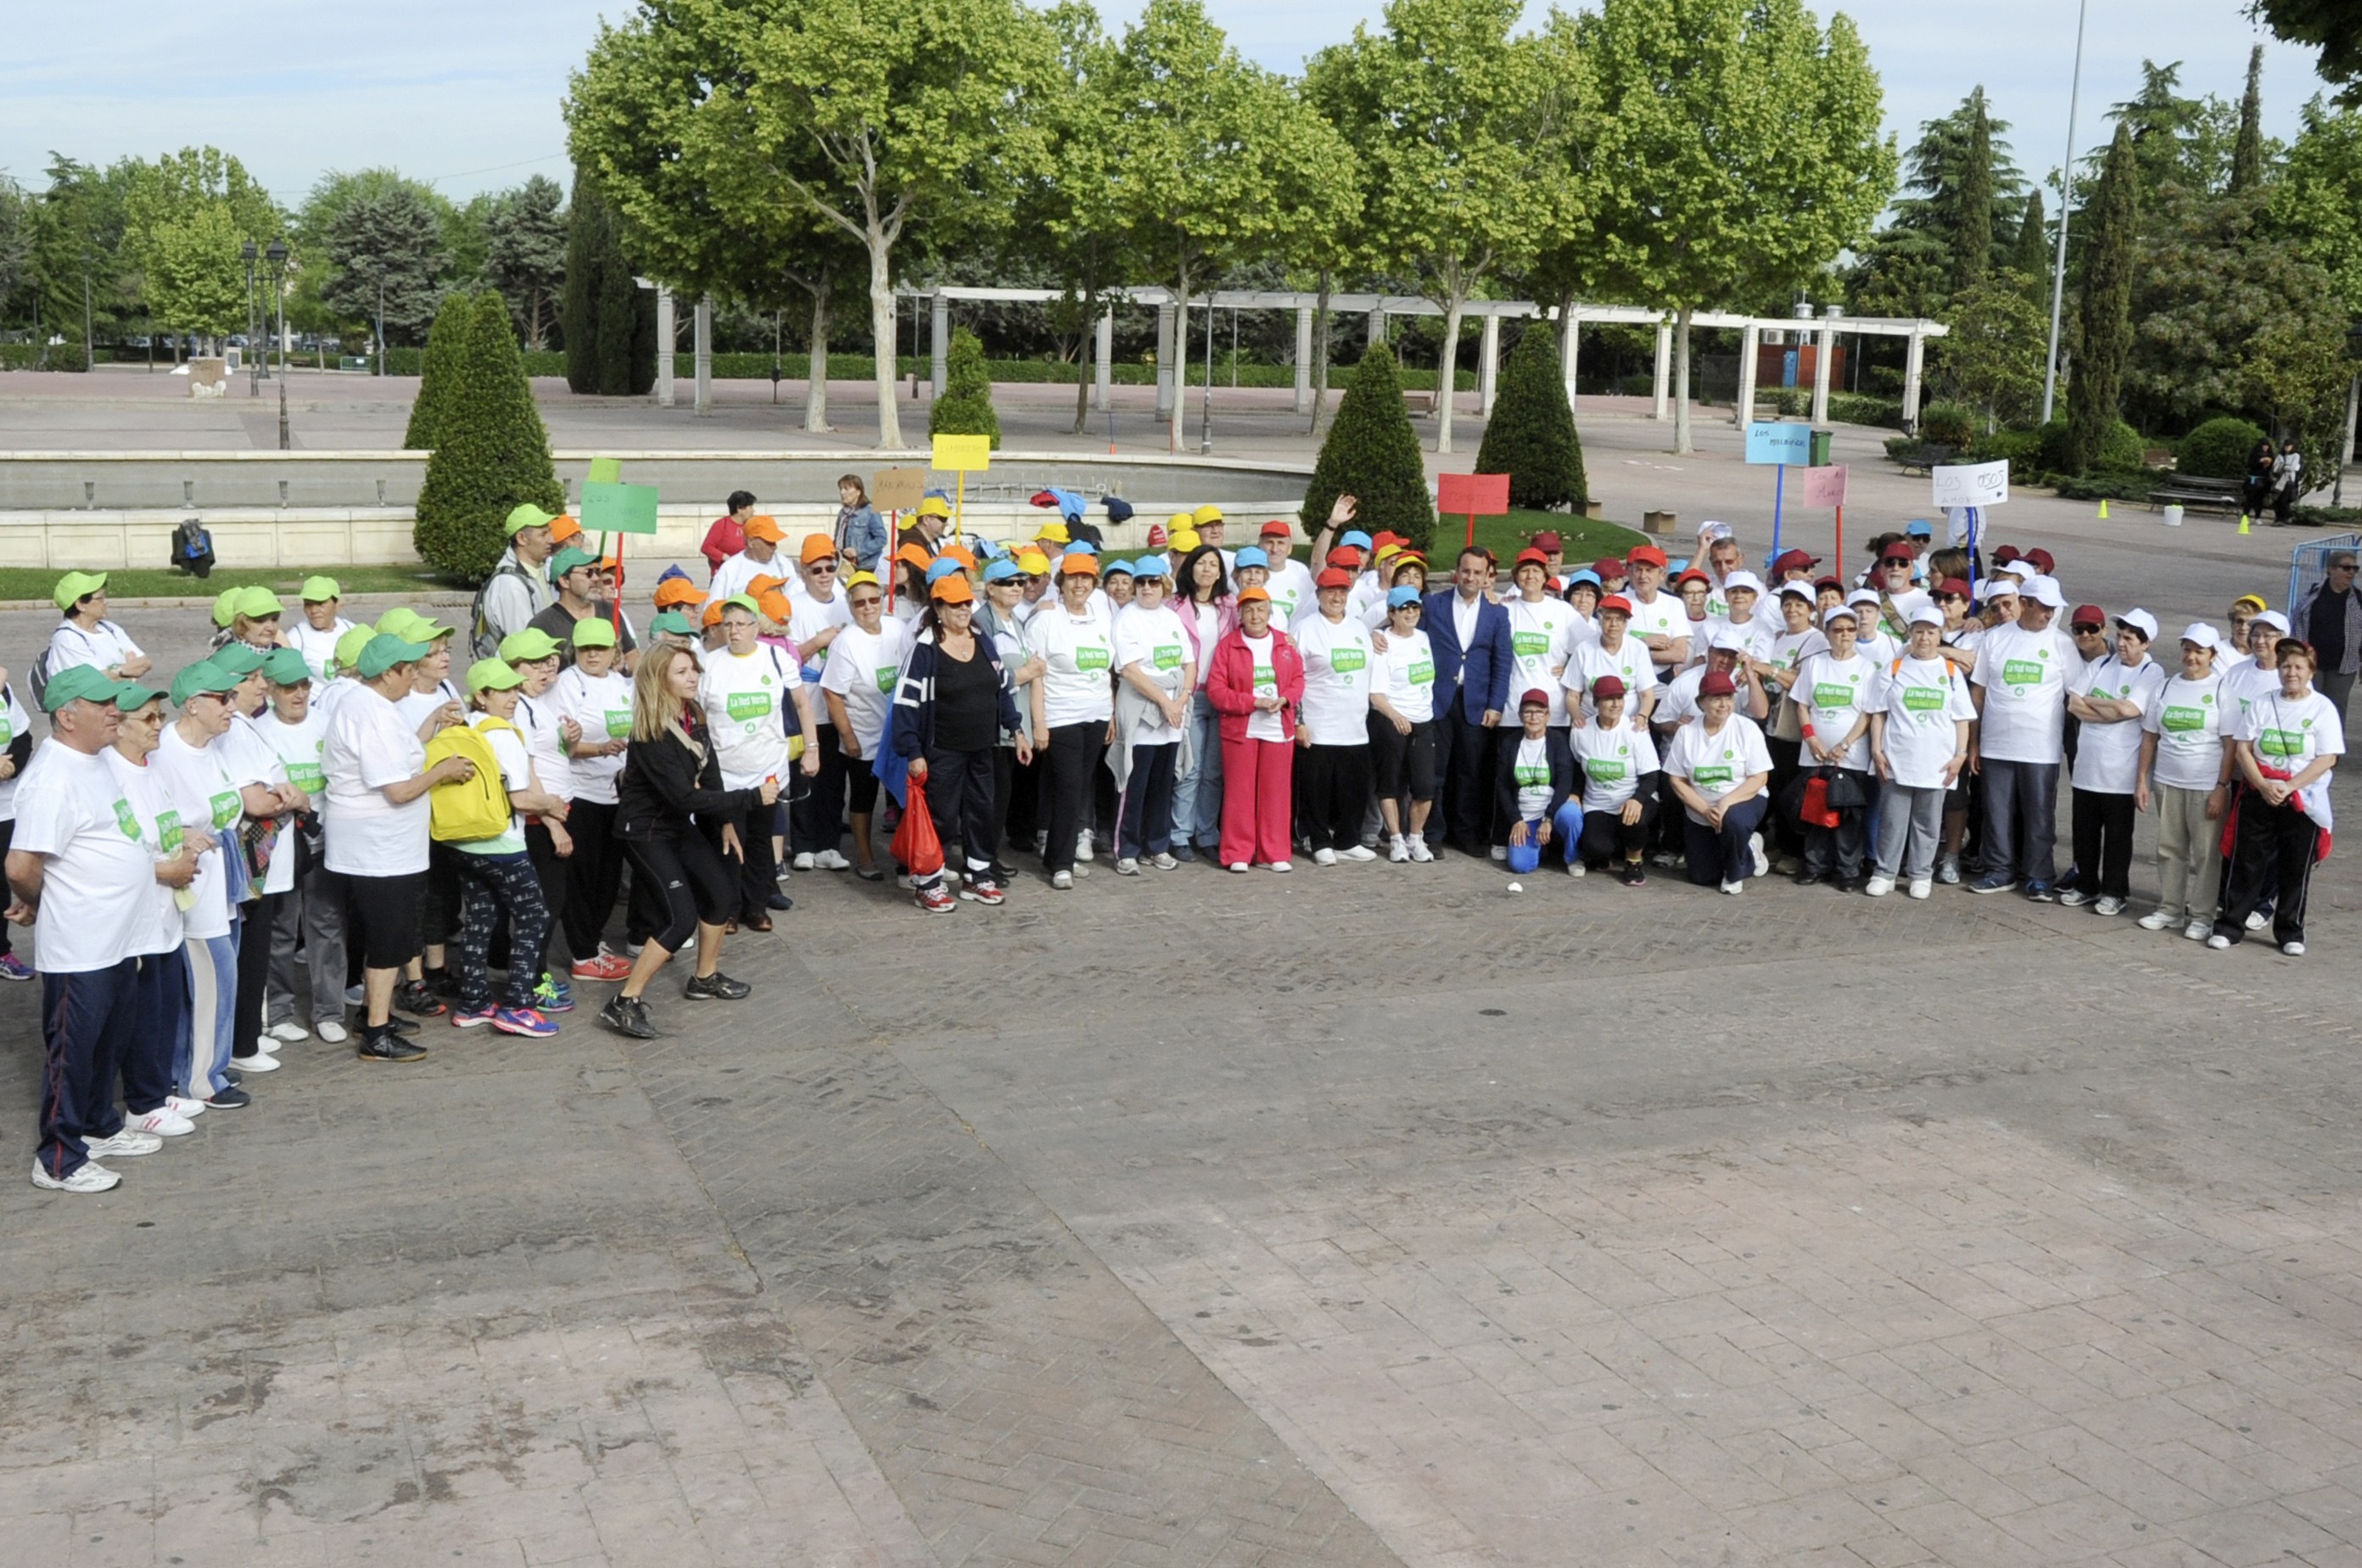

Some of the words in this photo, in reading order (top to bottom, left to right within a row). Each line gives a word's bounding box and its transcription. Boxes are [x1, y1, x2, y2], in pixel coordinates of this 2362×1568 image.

[2007, 664, 2013, 672] La
[2014, 664, 2024, 673] Red
[2024, 664, 2040, 674] Verde
[1824, 686, 1834, 695] Red
[1927, 691, 1942, 699] Verde
[730, 697, 738, 707] La
[738, 696, 750, 706] Red
[752, 695, 768, 704] Verde
